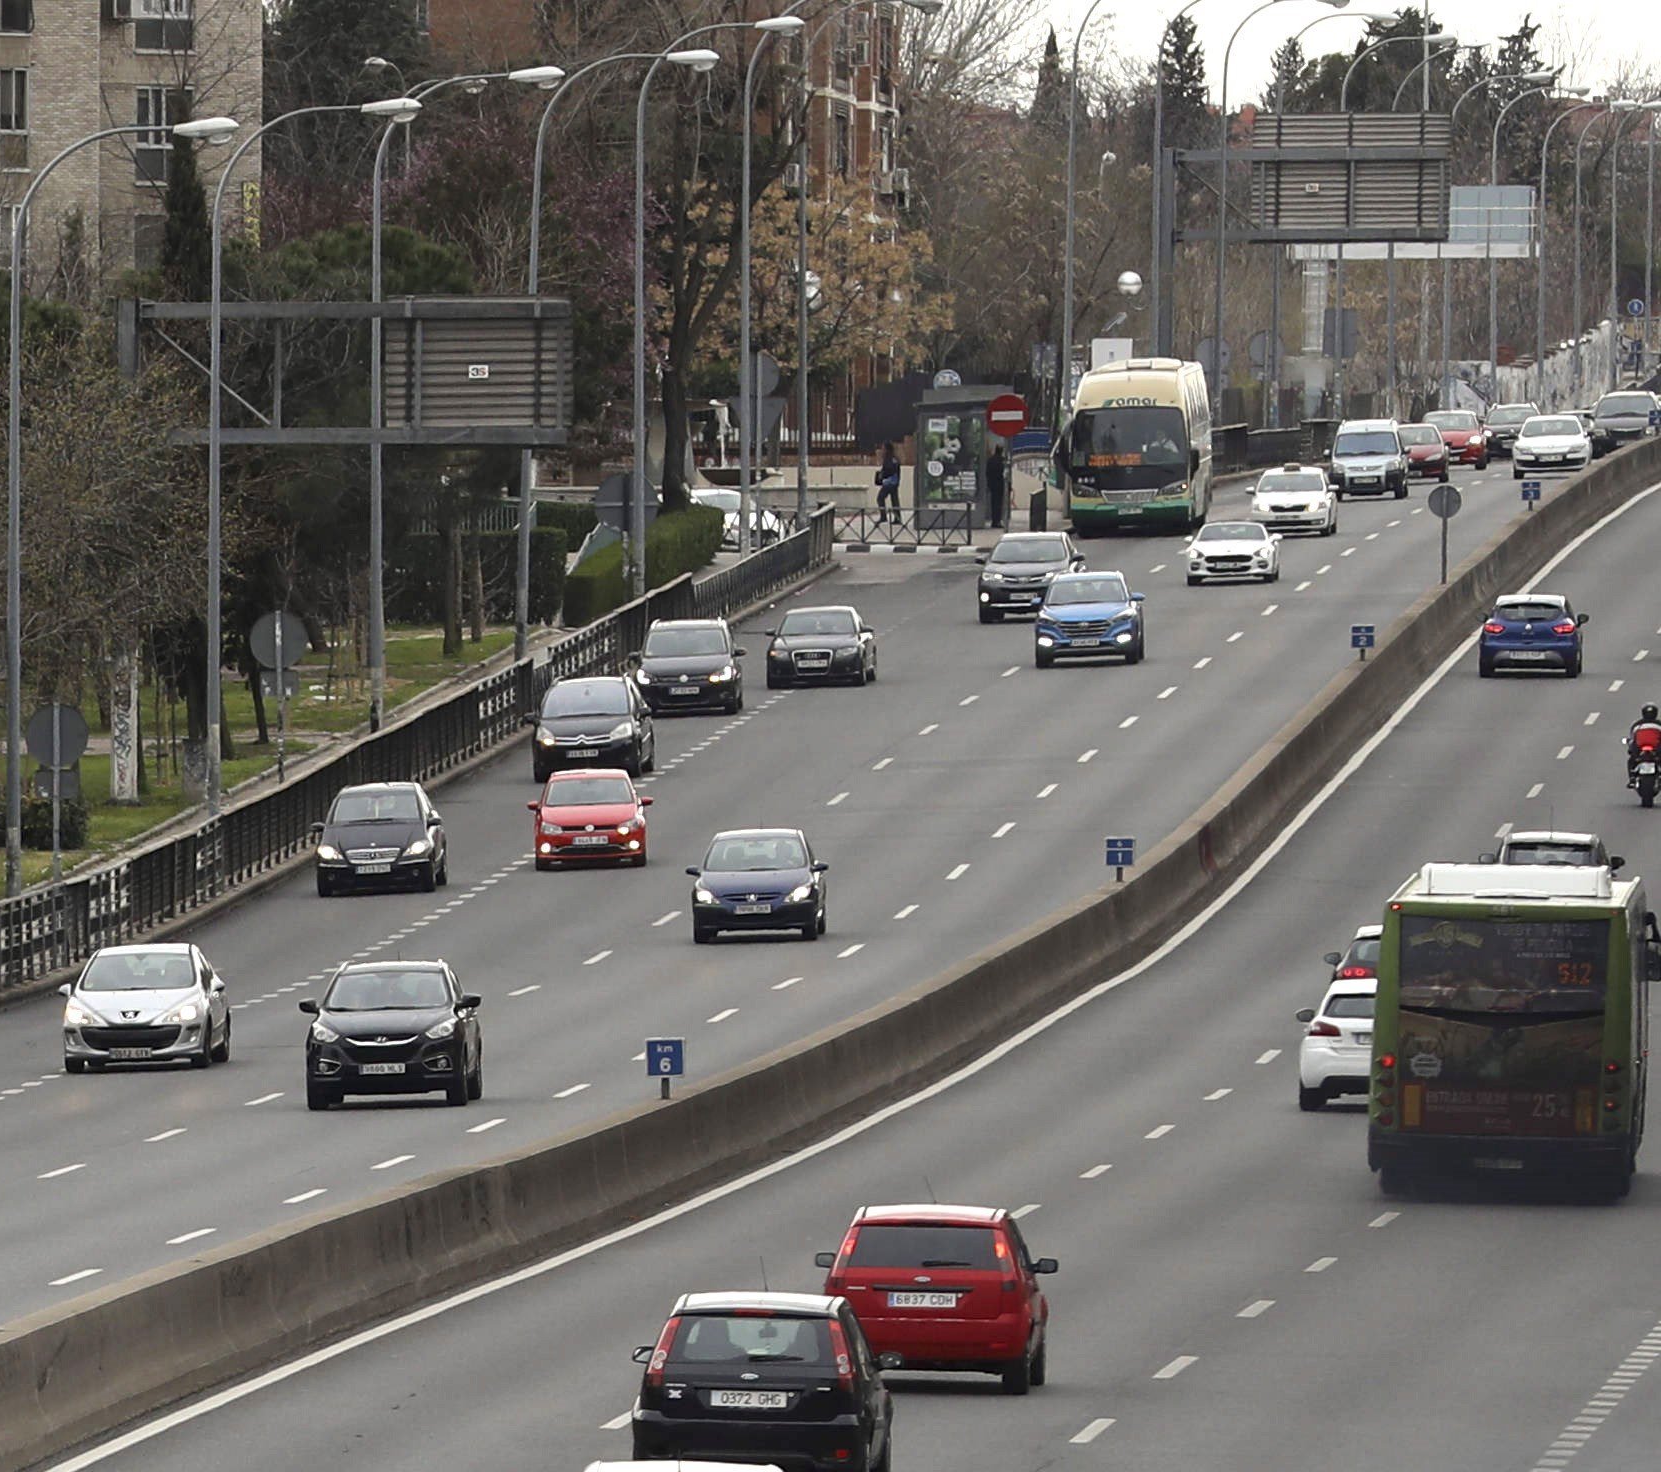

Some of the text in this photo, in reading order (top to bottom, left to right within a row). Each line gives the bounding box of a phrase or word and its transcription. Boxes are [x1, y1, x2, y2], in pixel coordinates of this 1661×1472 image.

[470, 367, 487, 377] 3S
[1117, 852, 1123, 863] 1
[657, 1044, 674, 1053] km
[660, 1057, 672, 1073] 6
[720, 1392, 753, 1405] 0372
